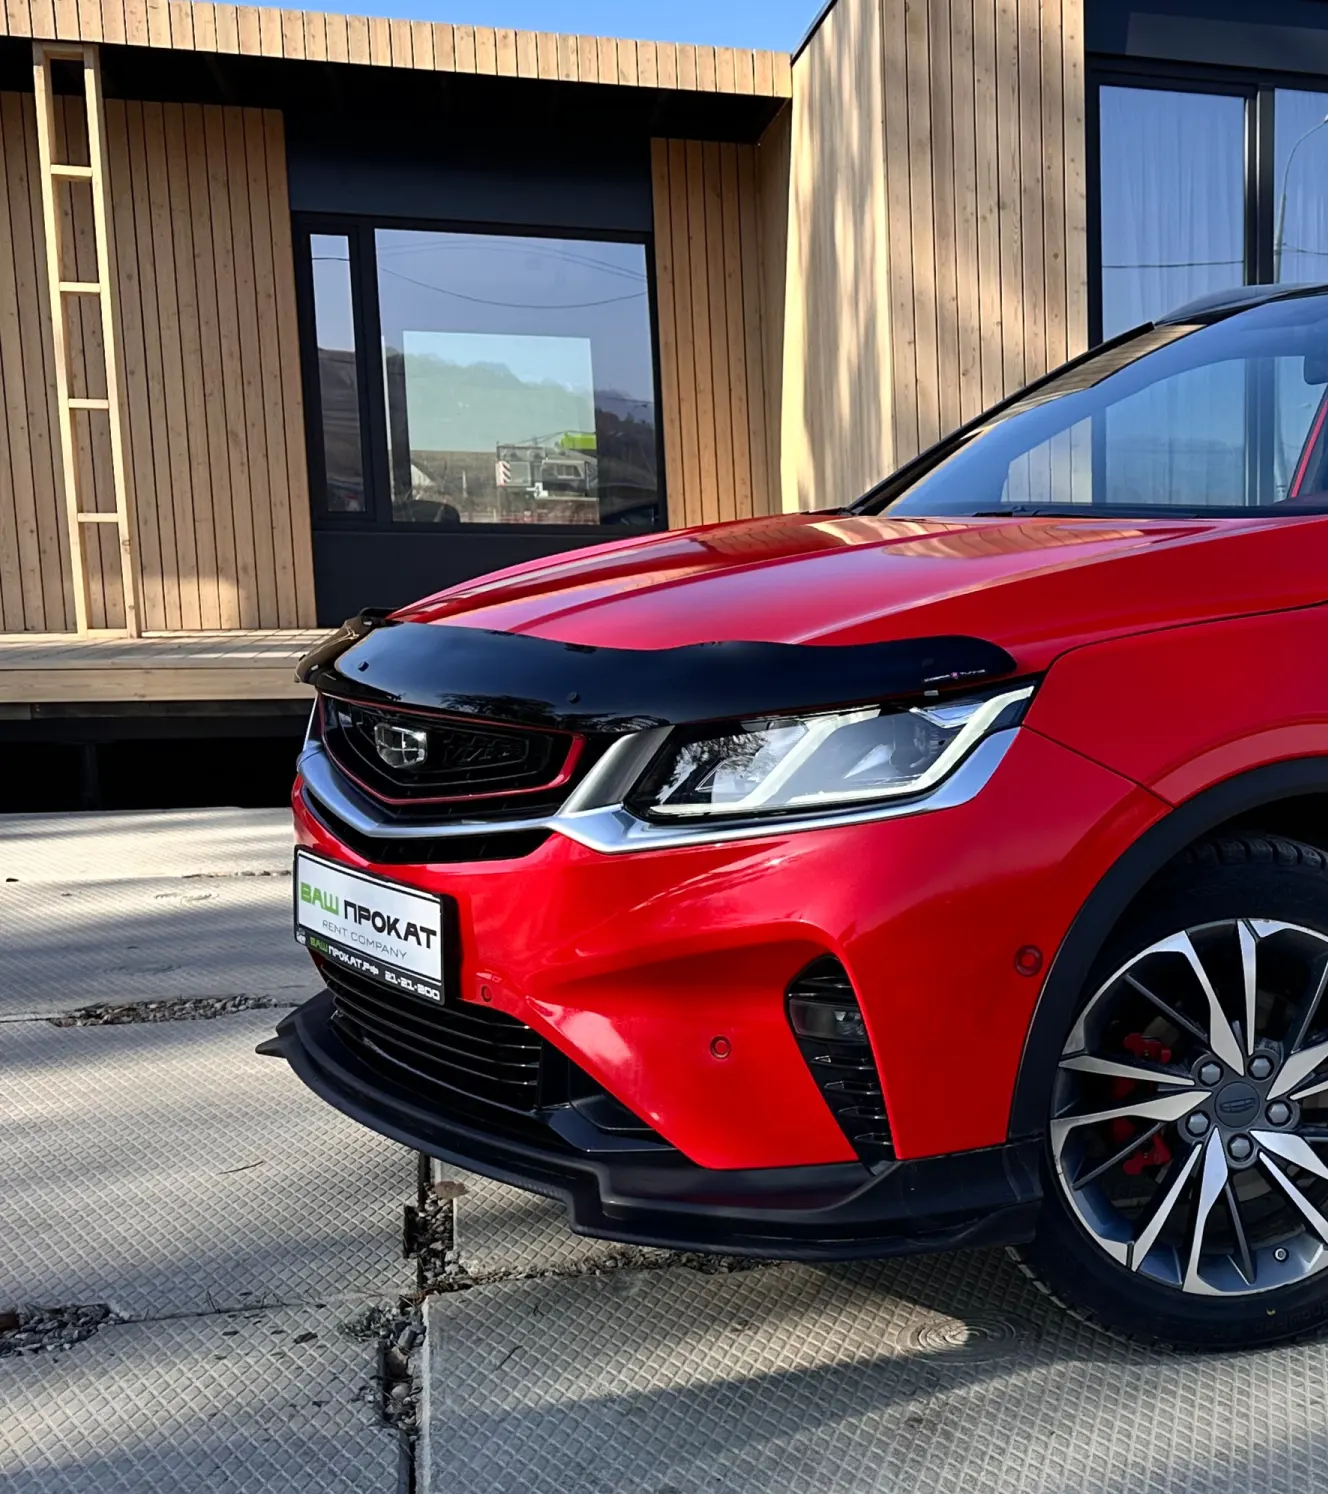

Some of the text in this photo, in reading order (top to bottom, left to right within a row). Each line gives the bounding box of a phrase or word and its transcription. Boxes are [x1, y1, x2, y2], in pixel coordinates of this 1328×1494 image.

[301, 882, 437, 949] ВАШ ПРОКАТ
[322, 920, 407, 959] RENT COMPANY
